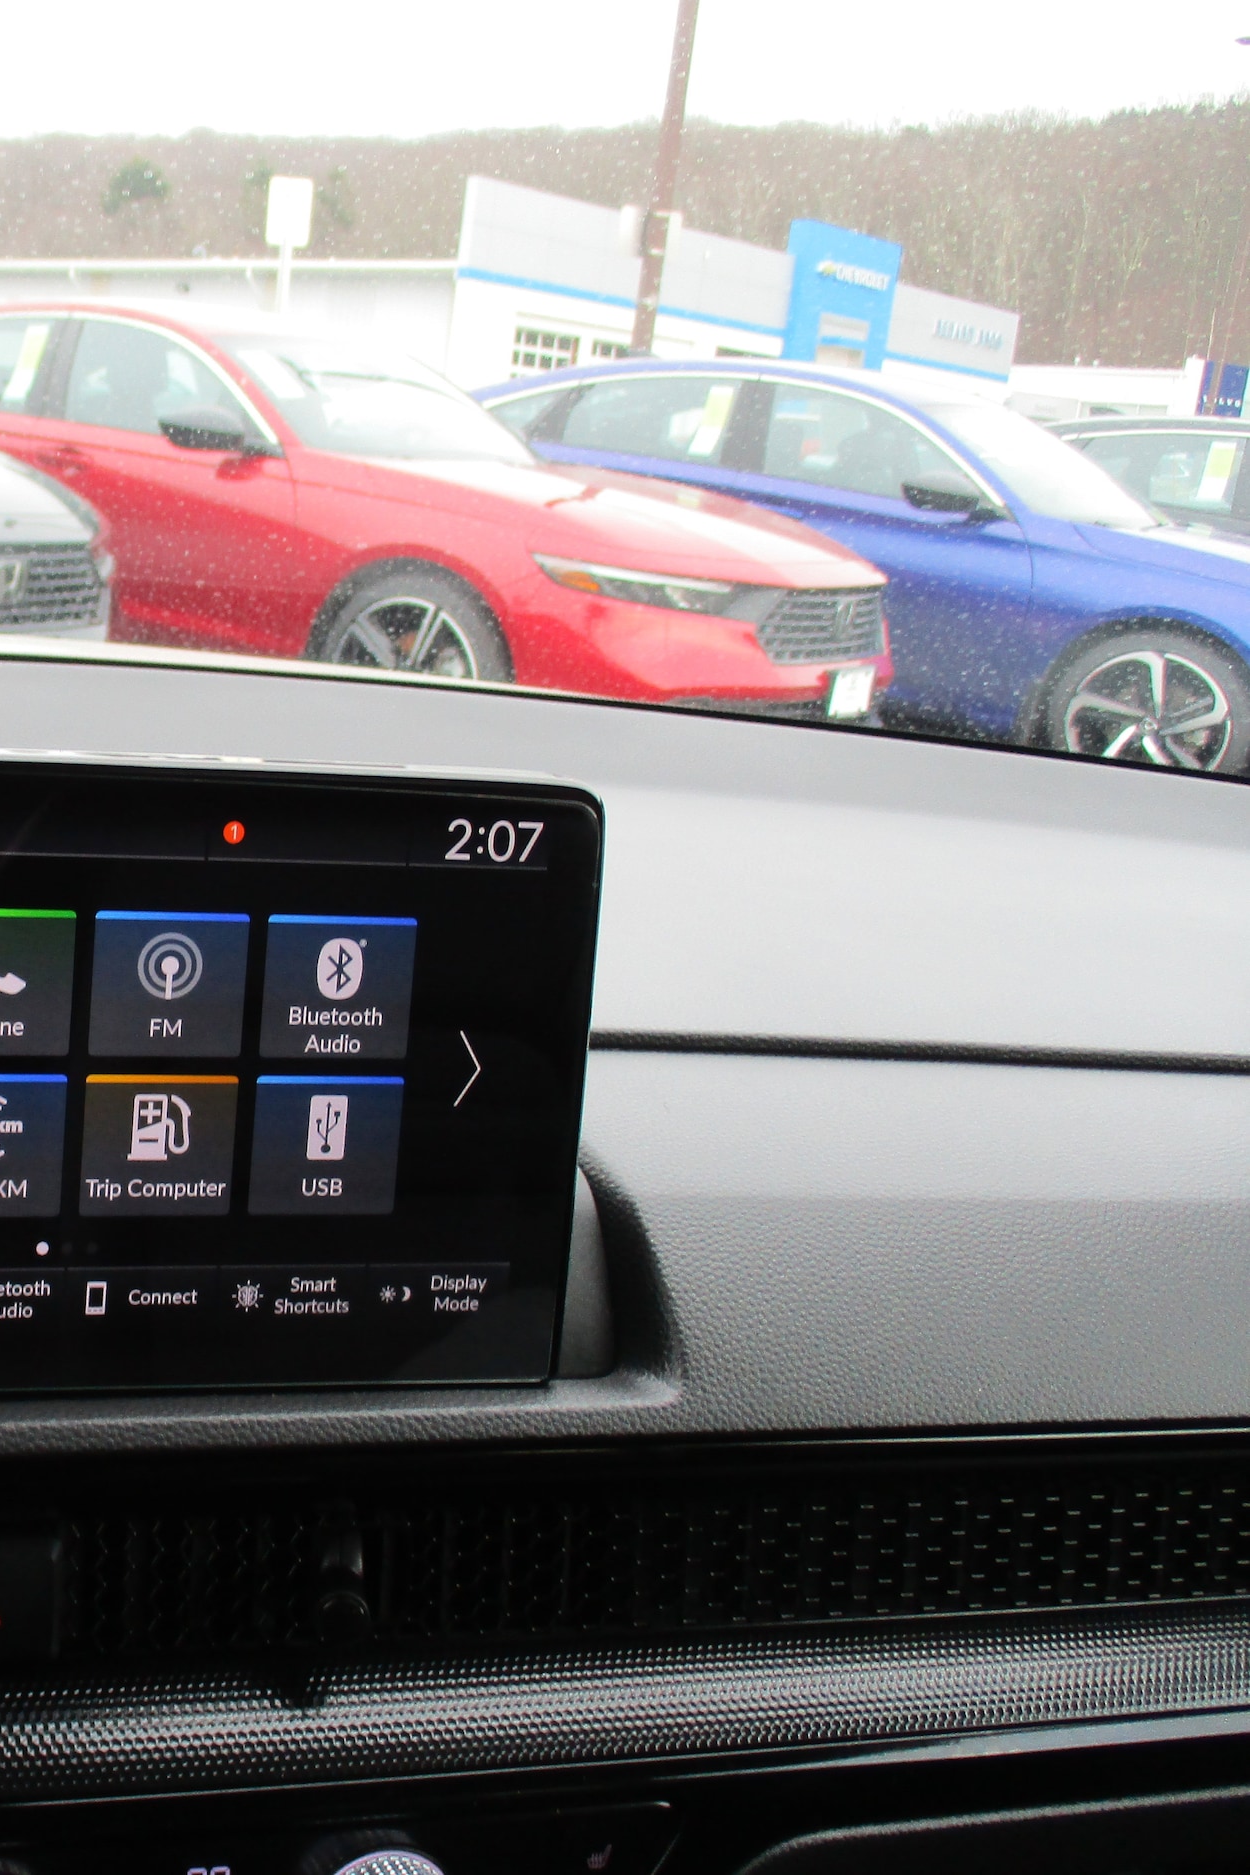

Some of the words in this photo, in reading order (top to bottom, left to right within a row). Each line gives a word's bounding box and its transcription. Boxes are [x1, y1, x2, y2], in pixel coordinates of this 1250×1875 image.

[444, 818, 544, 863] 2:07
[288, 1005, 383, 1026] Bluetooth
[149, 1018, 183, 1038] FM
[304, 1033, 361, 1054] Audio
[85, 1178, 122, 1201] Trip
[127, 1178, 227, 1201] Computer
[301, 1178, 343, 1197] USB
[290, 1276, 337, 1293] Smart
[430, 1274, 487, 1294] Display
[128, 1289, 198, 1306] Connect
[274, 1297, 349, 1315] Shortcuts
[434, 1295, 479, 1312] Mode
